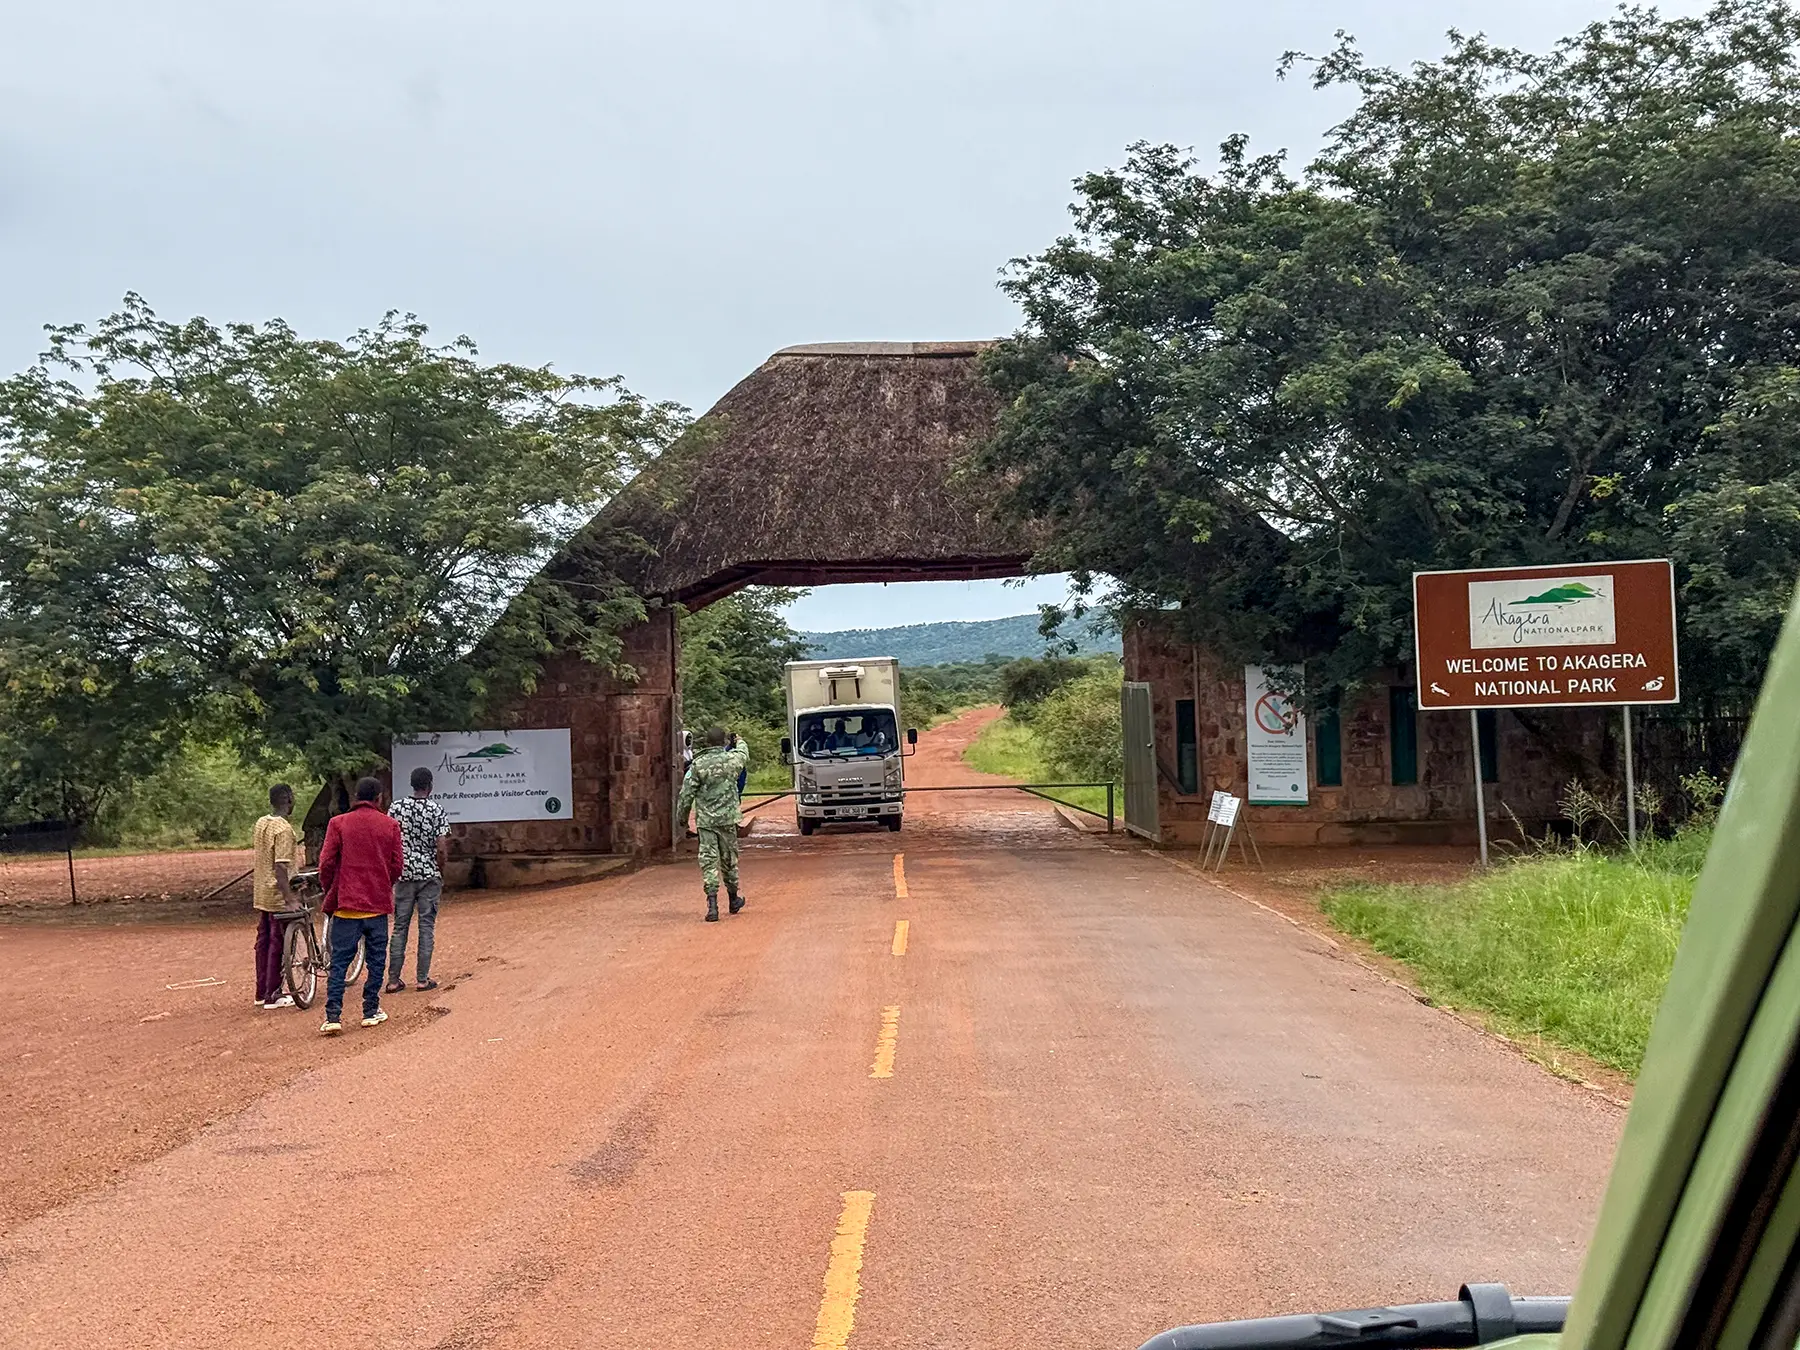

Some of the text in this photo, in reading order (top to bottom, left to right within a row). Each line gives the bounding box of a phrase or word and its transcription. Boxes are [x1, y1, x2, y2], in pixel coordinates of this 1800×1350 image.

[1479, 597, 1550, 643] Akagera
[1446, 653, 1647, 674] WELCOME TO AKAGERA
[1474, 677, 1616, 696] NATIONAL PARK
[436, 753, 483, 786] Akagera
[459, 791, 493, 799] Reception
